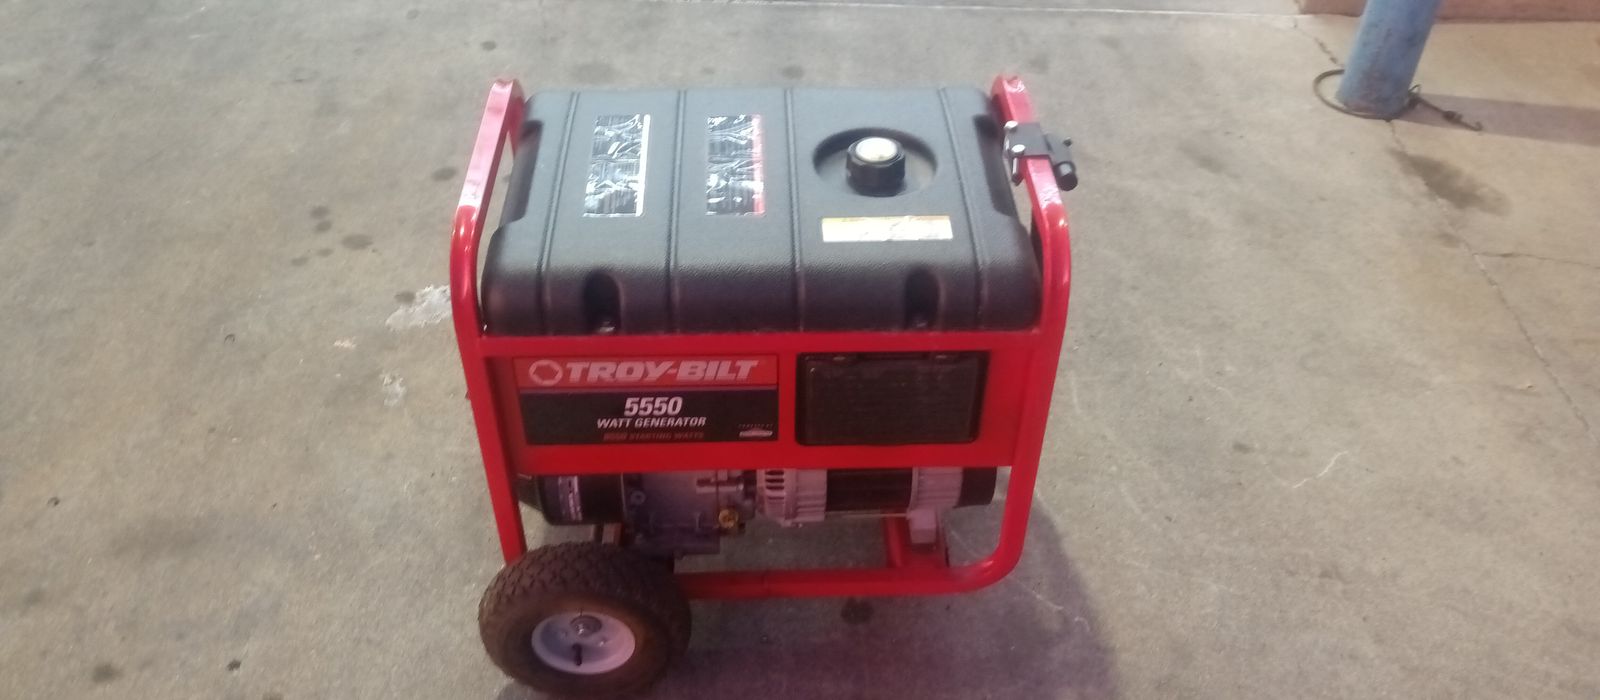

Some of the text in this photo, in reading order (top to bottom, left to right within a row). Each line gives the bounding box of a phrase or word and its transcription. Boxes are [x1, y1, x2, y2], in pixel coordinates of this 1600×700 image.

[566, 360, 759, 383] TROY-BILT
[624, 396, 683, 417] 5550
[597, 416, 707, 429] WATT GENERATOR
